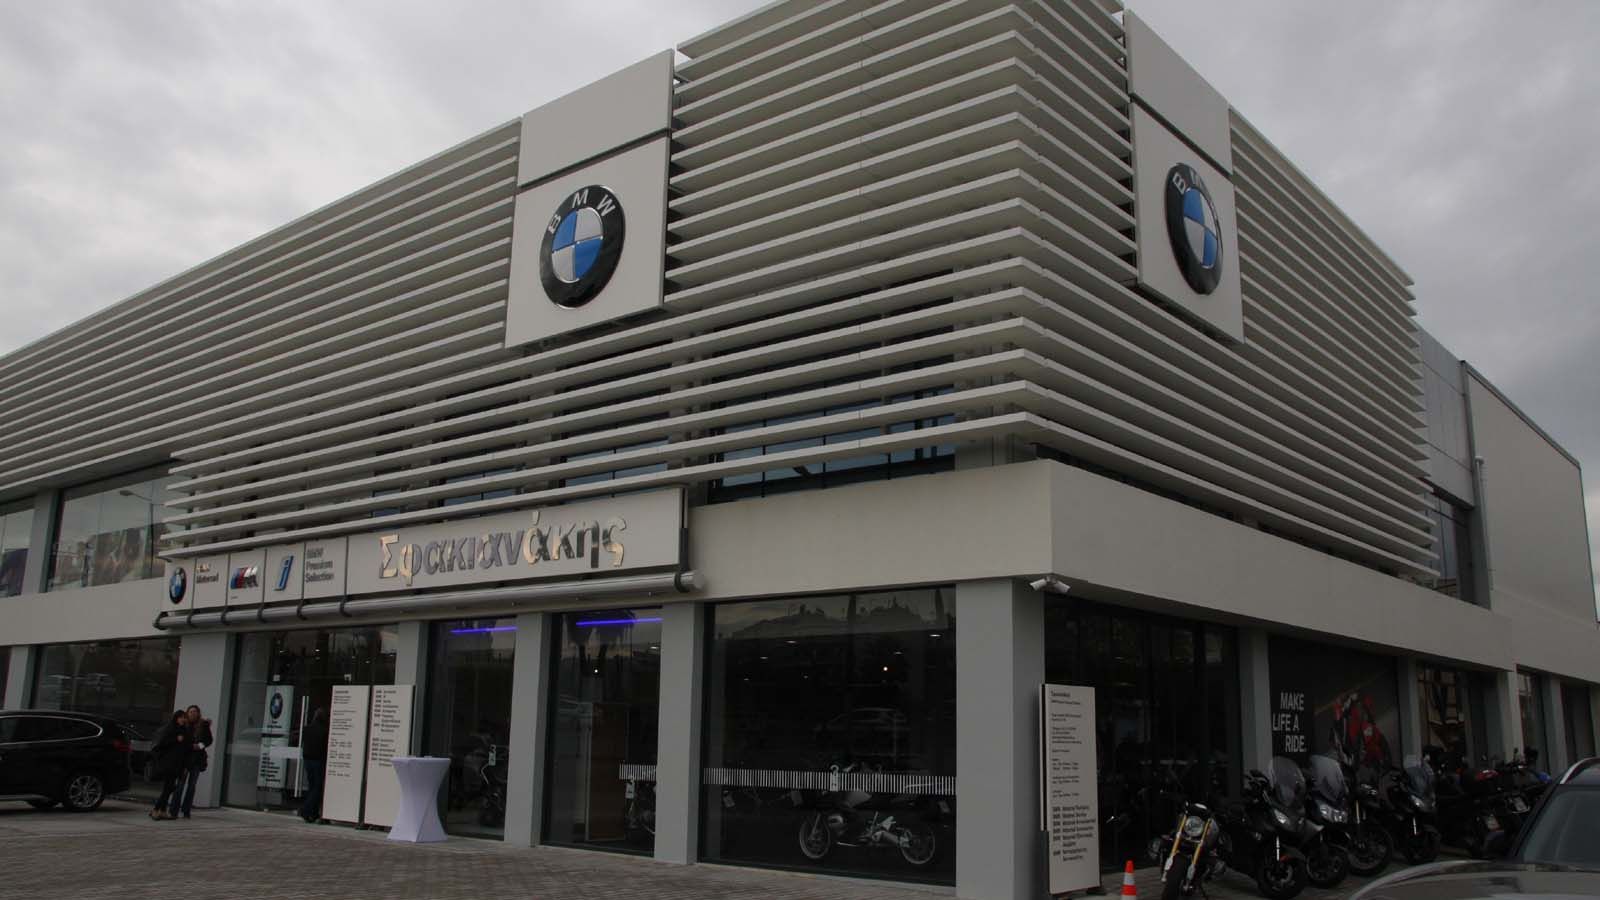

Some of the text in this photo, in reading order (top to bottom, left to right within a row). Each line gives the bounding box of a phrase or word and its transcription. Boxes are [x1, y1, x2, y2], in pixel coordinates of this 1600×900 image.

[548, 188, 616, 234] BMW
[380, 511, 627, 586] Σφακιανάκης
[1280, 691, 1304, 711] MAKE
[1272, 711, 1300, 732] LIFE A
